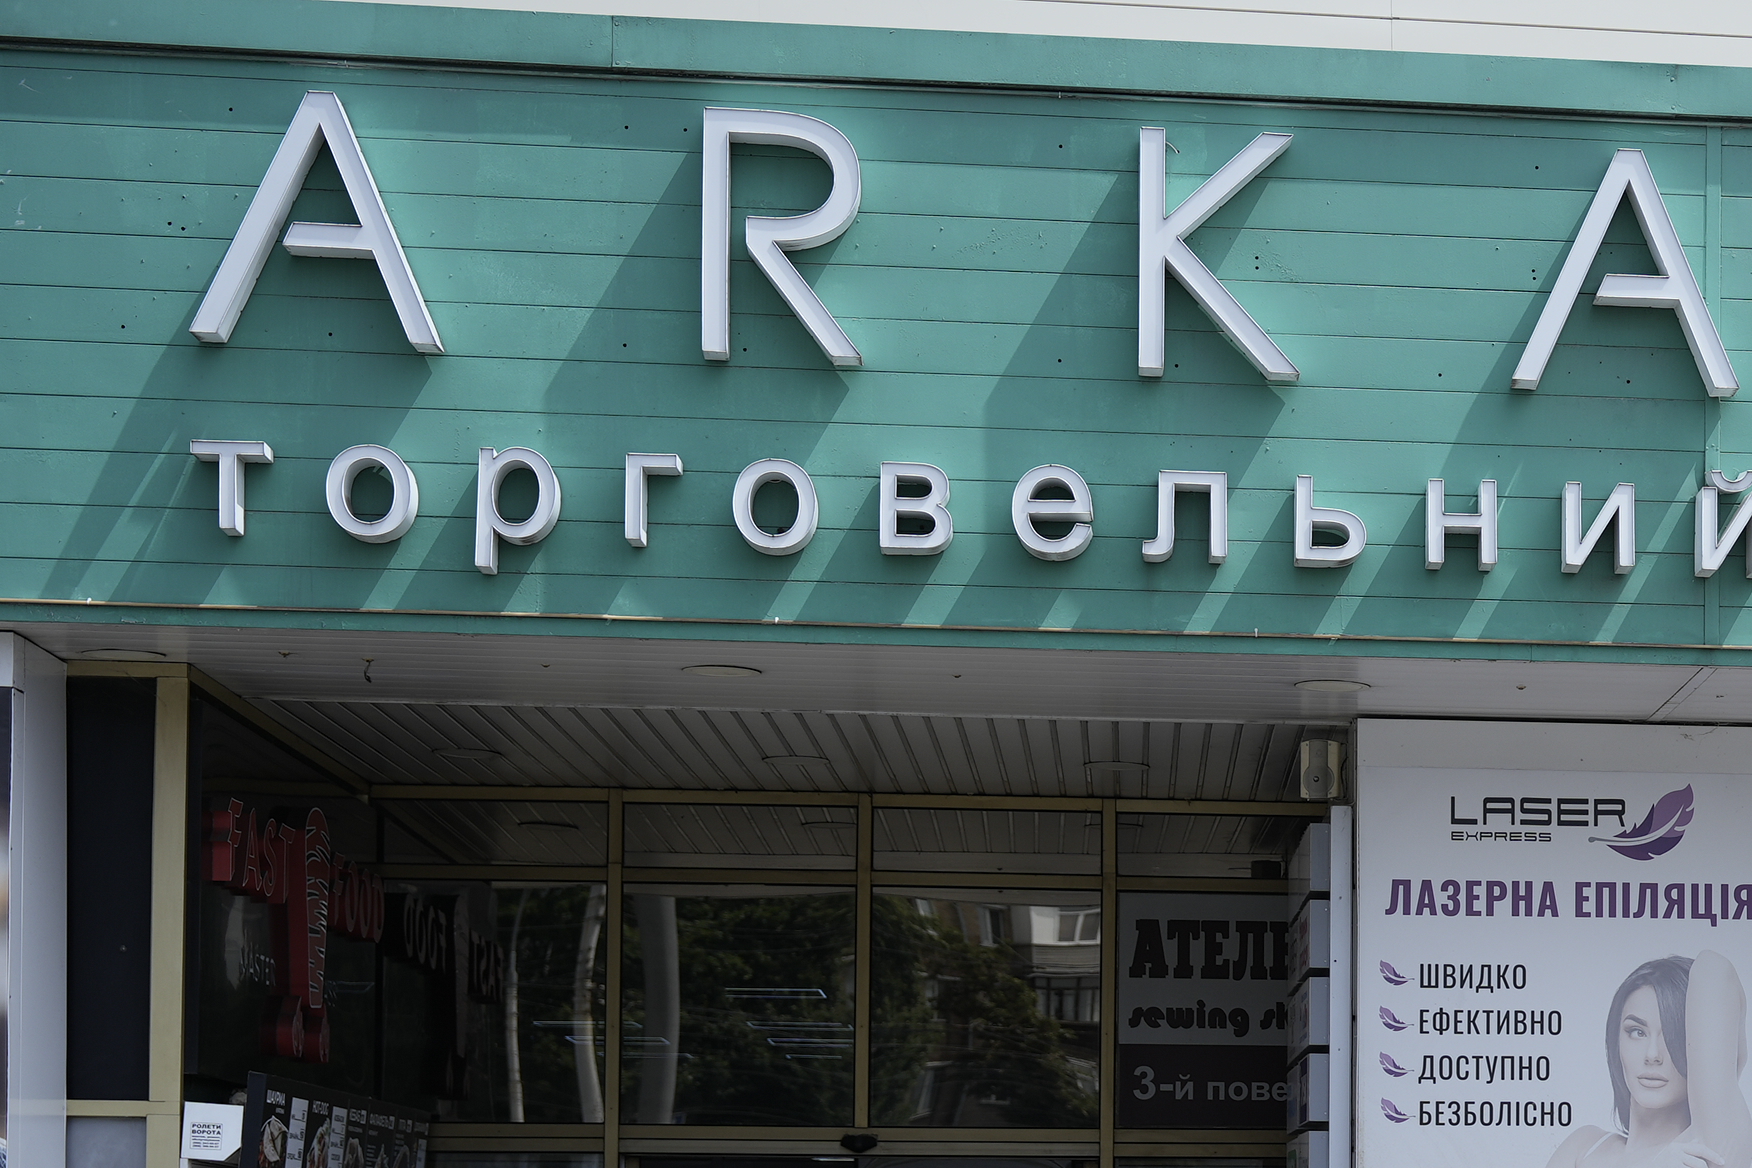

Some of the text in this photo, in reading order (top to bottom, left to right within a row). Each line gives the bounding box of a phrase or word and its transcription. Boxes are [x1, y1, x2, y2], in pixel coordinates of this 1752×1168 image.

[1450, 796, 1626, 828] LASER
[1450, 831, 1552, 842] EXPRESS
[229, 797, 385, 944] FAST FOOD
[1385, 878, 1559, 918] ЛАЗЕРНА
[1418, 962, 1527, 992] ШВИДКО
[1128, 999, 1250, 1037] sewing
[1418, 1007, 1563, 1037] ЕФЕКТИВНО
[1133, 1065, 1194, 1101] 3-й
[1418, 1054, 1551, 1084] ДОСТУПНО
[1418, 1100, 1573, 1128] БЕЗБОЛІСНО
